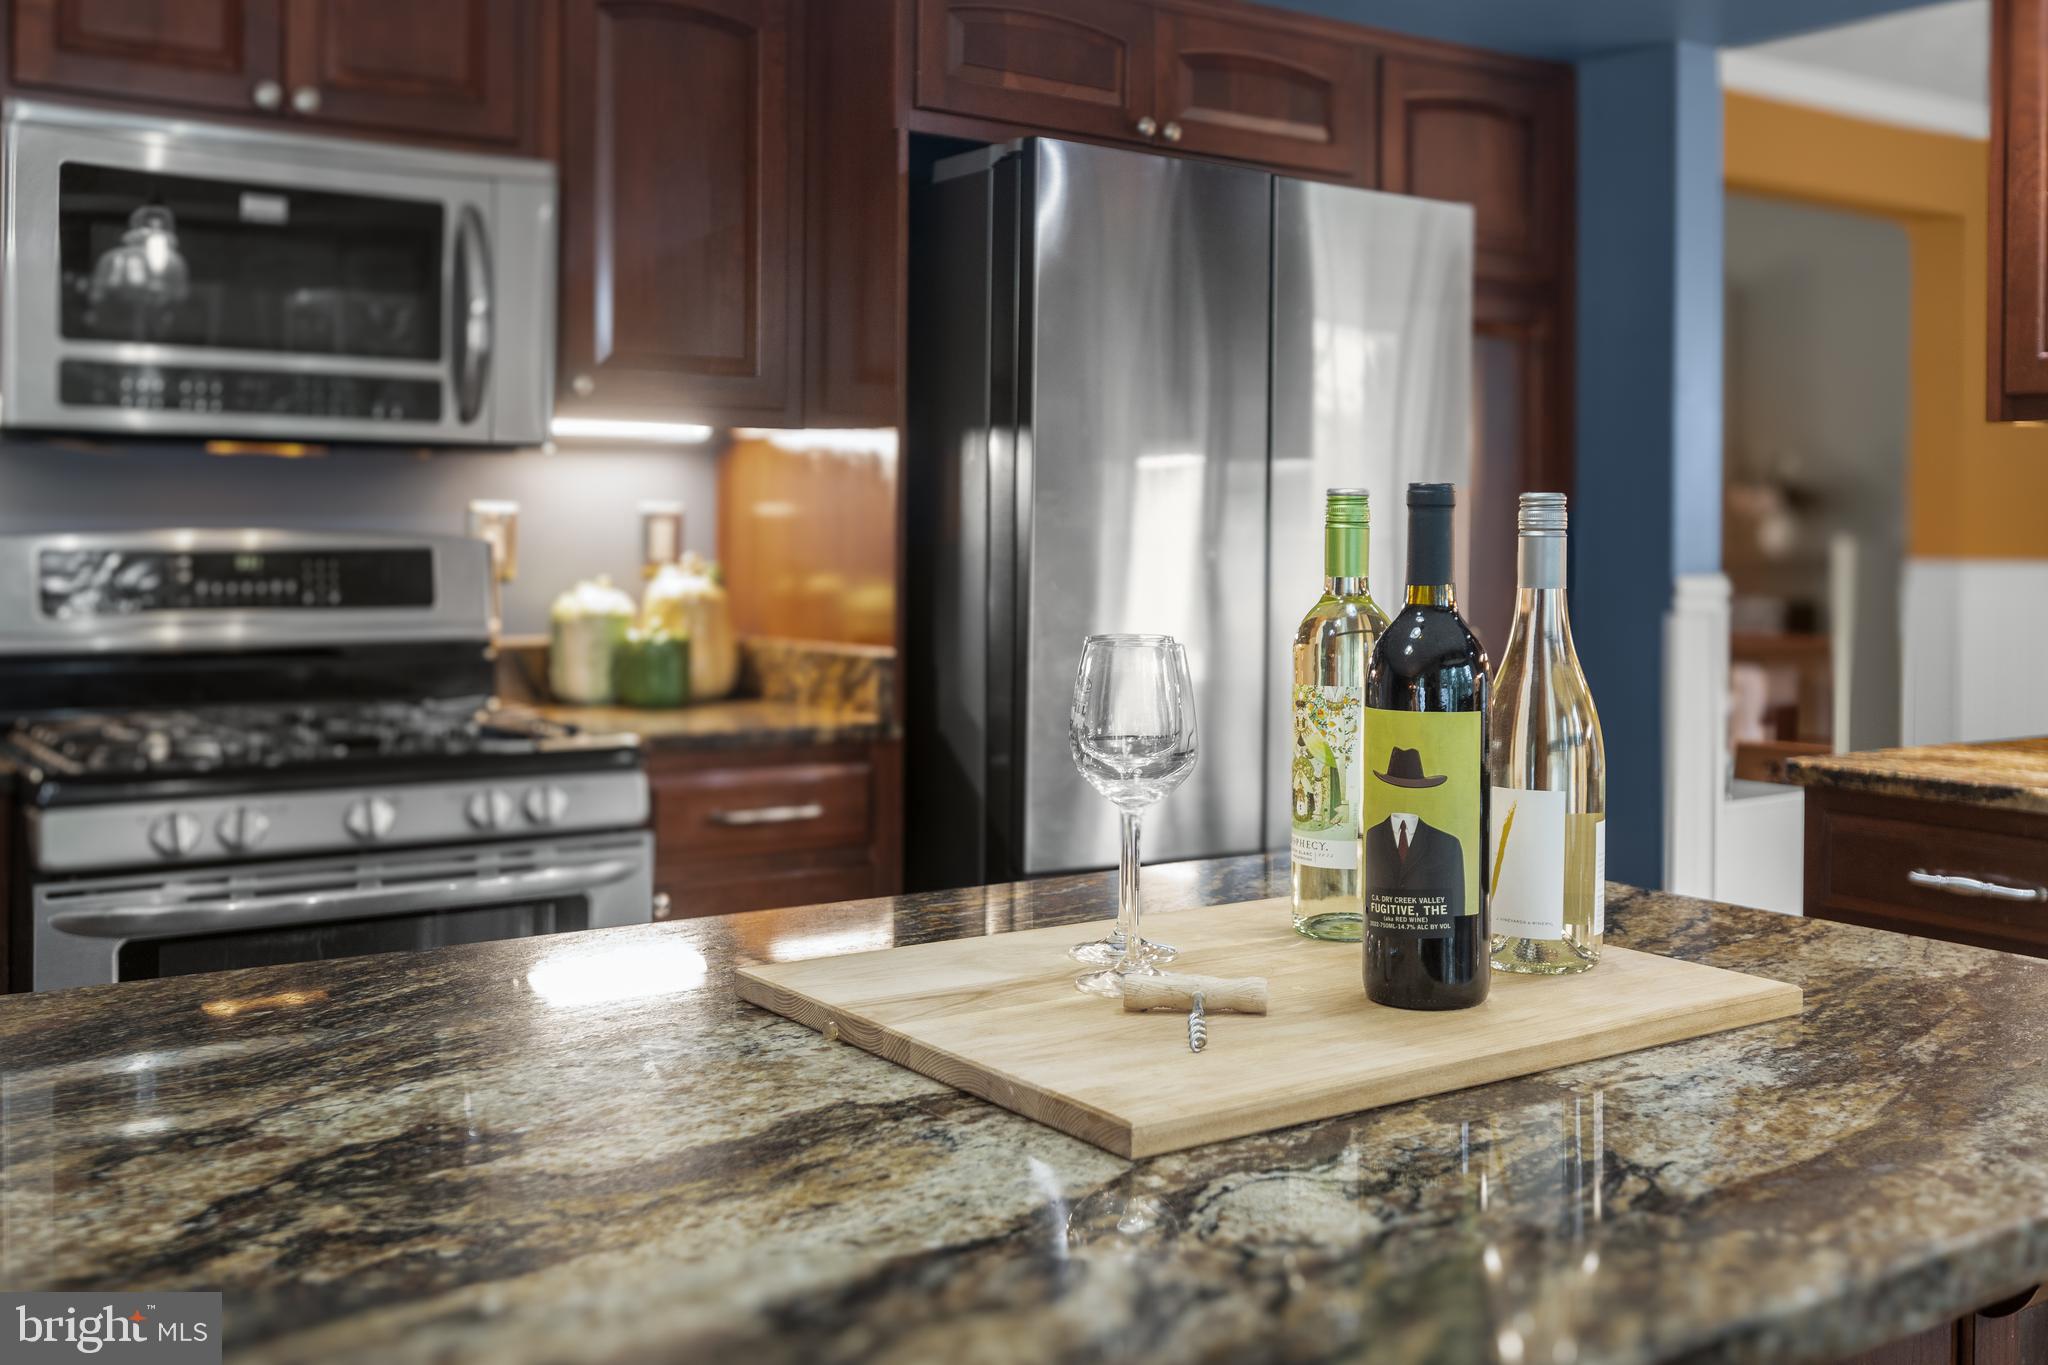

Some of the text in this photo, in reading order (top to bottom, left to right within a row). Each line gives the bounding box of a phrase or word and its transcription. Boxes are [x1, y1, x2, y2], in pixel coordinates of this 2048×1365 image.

[1381, 895, 1393, 903] DRY
[1394, 896, 1417, 904] CREEK
[1418, 896, 1446, 904] VALLEY
[1370, 902, 1448, 917] FUGITIVE, THE
